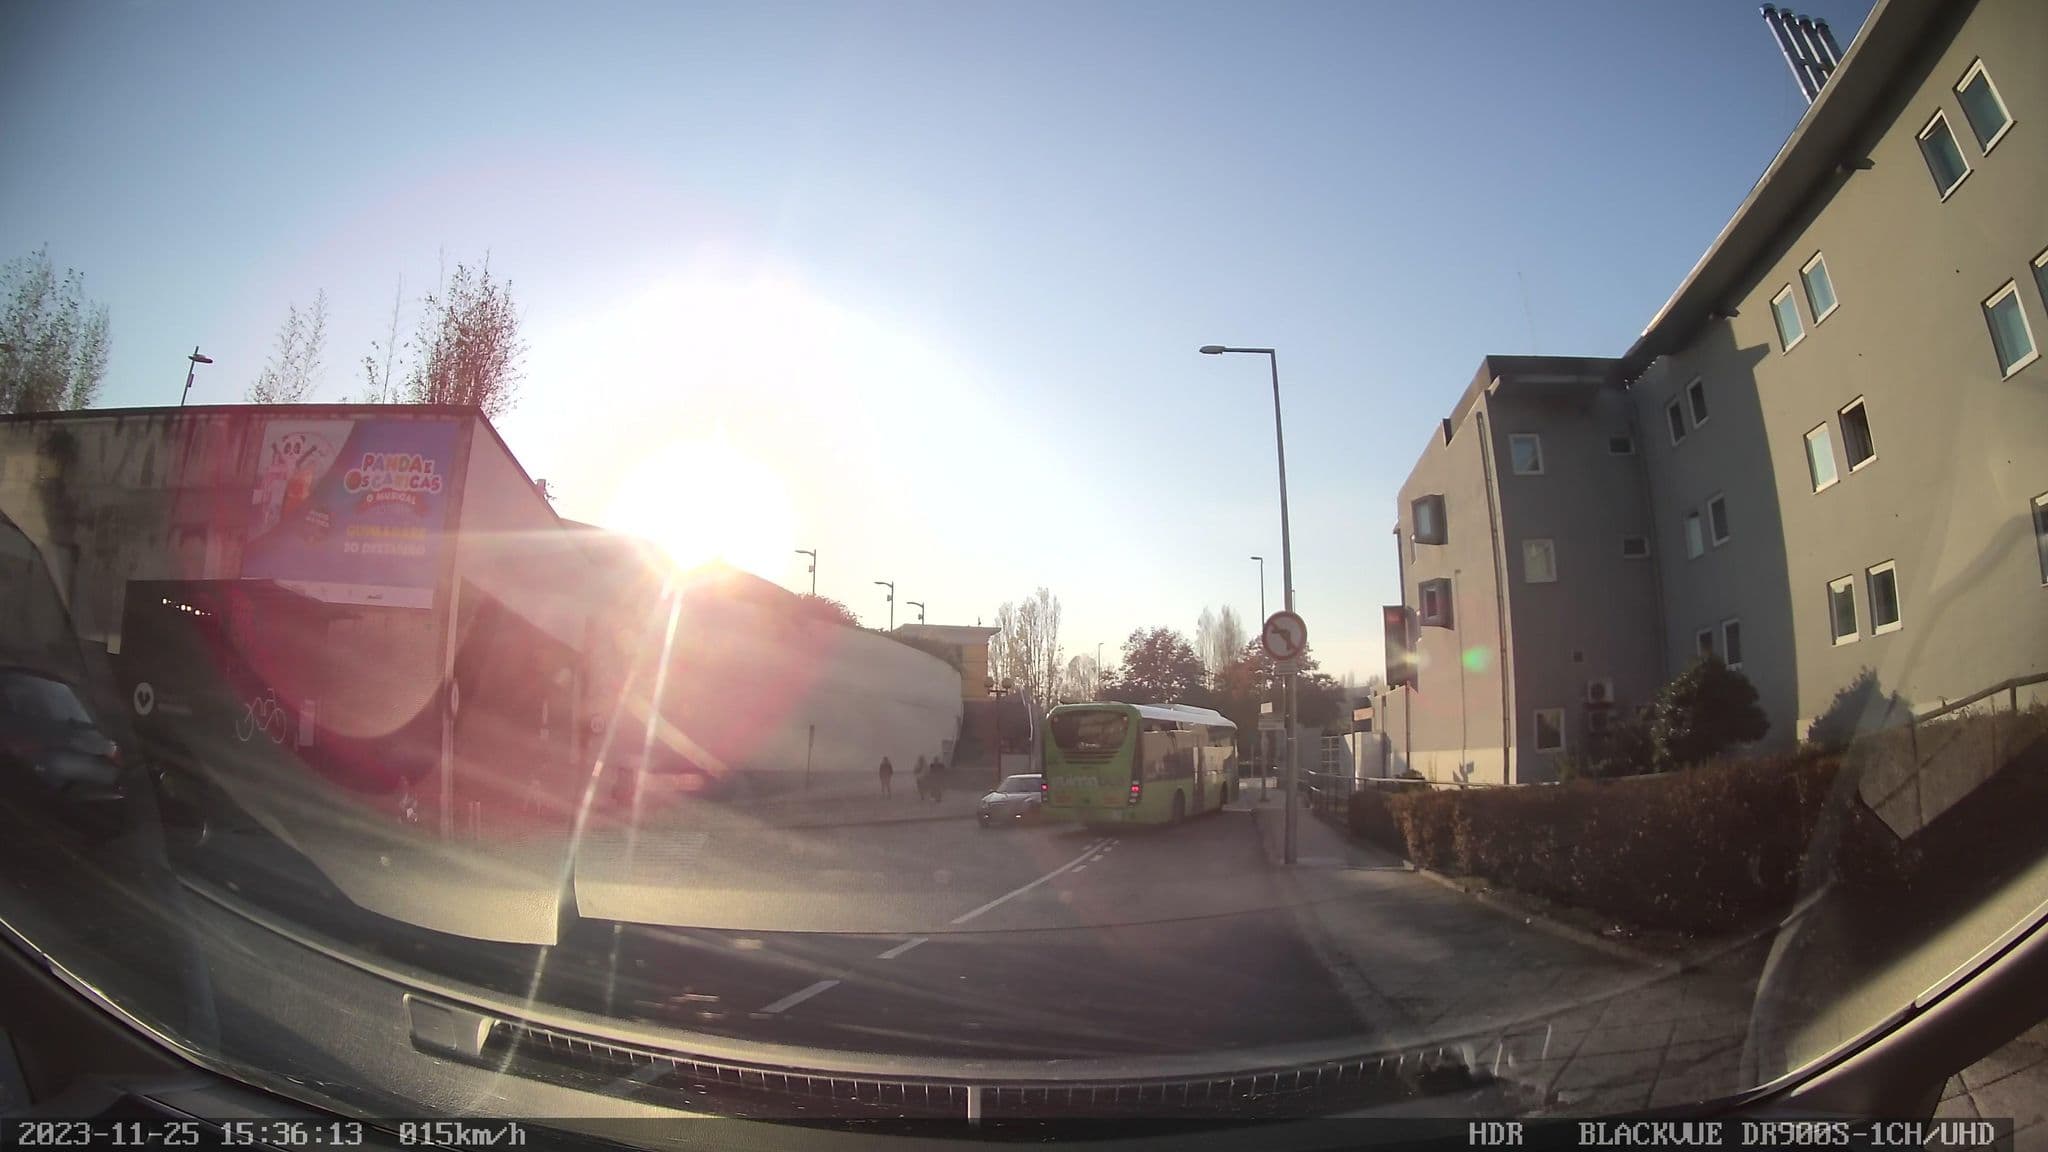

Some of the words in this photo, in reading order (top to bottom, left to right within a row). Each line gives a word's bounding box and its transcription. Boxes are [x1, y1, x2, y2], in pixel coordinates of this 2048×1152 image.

[362, 453, 424, 473] PANDA
[366, 494, 374, 503] O
[375, 491, 417, 505] MUSICAL
